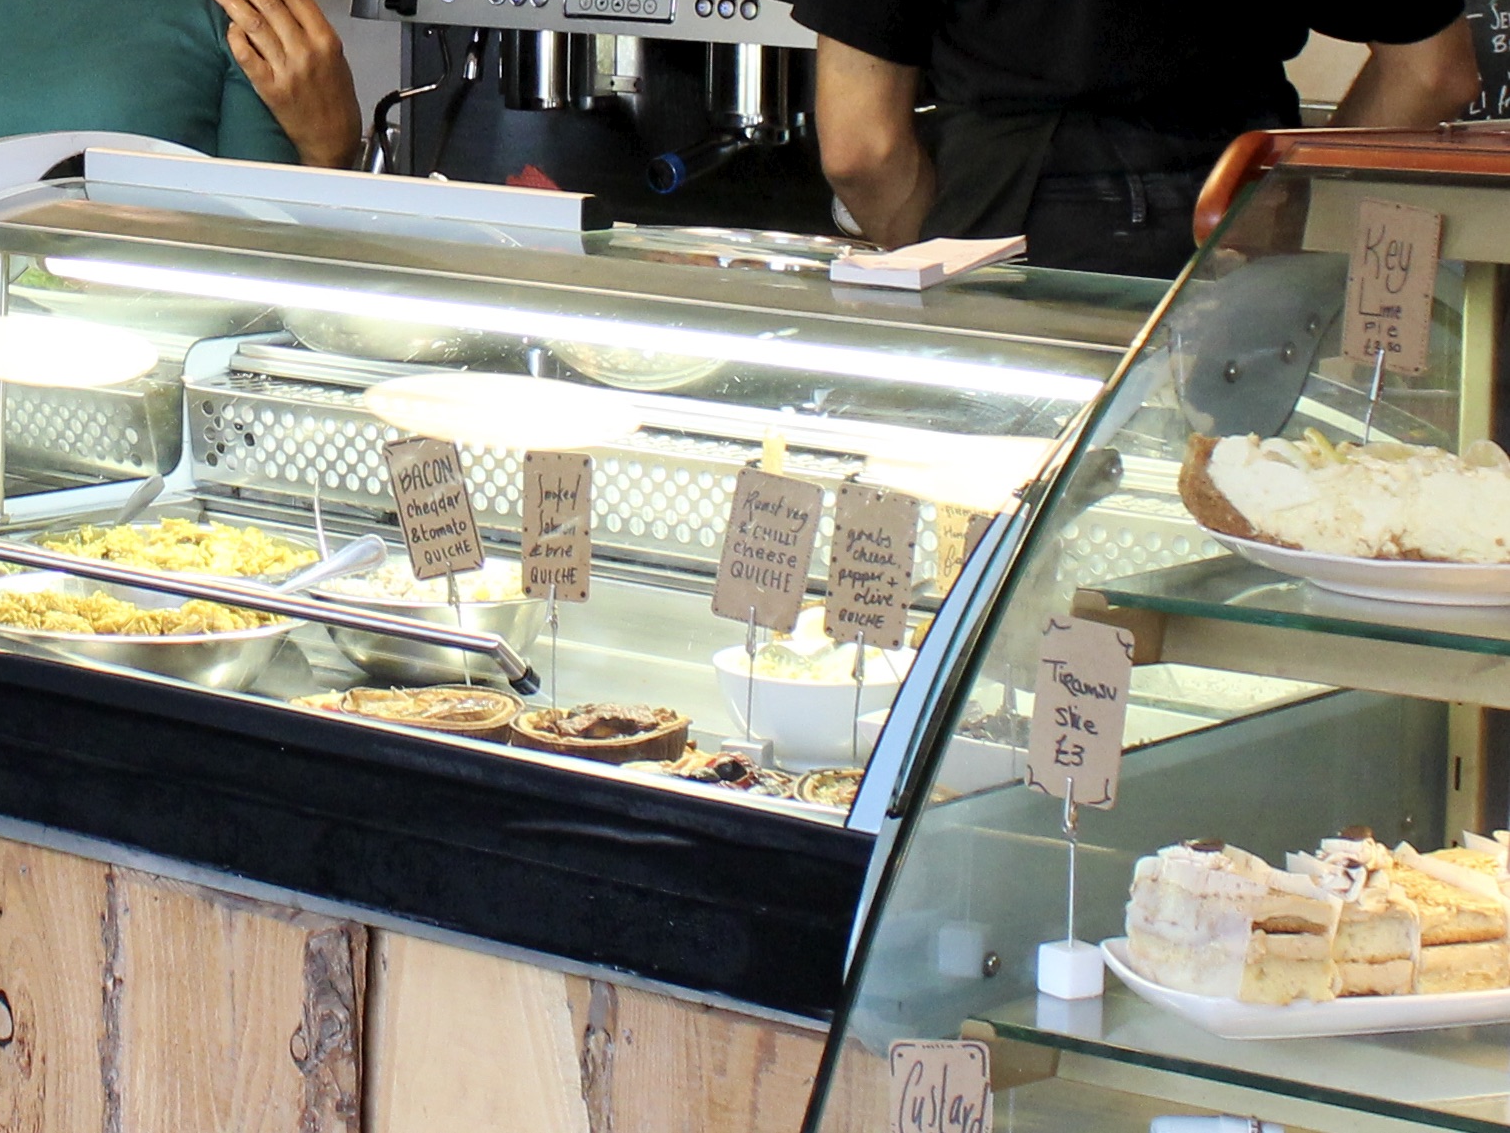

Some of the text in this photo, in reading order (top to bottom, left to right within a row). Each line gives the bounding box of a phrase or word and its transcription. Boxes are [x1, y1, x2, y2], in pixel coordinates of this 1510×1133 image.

[1364, 224, 1413, 294] Key
[398, 455, 454, 495] BACON
[406, 491, 462, 518] cheddar
[538, 474, 581, 513] Smoked
[743, 490, 809, 533] Roast veg
[752, 525, 797, 546] CHILLI
[424, 540, 473, 565] QUICHE
[545, 543, 573, 558] brie
[734, 540, 797, 568] cheese
[530, 567, 578, 585] QUICHE
[730, 561, 793, 593] QUICHE
[854, 587, 893, 607] olive
[838, 608, 885, 628] QUICHE
[1054, 734, 1085, 766] £3
[899, 1060, 991, 1133] Custard
